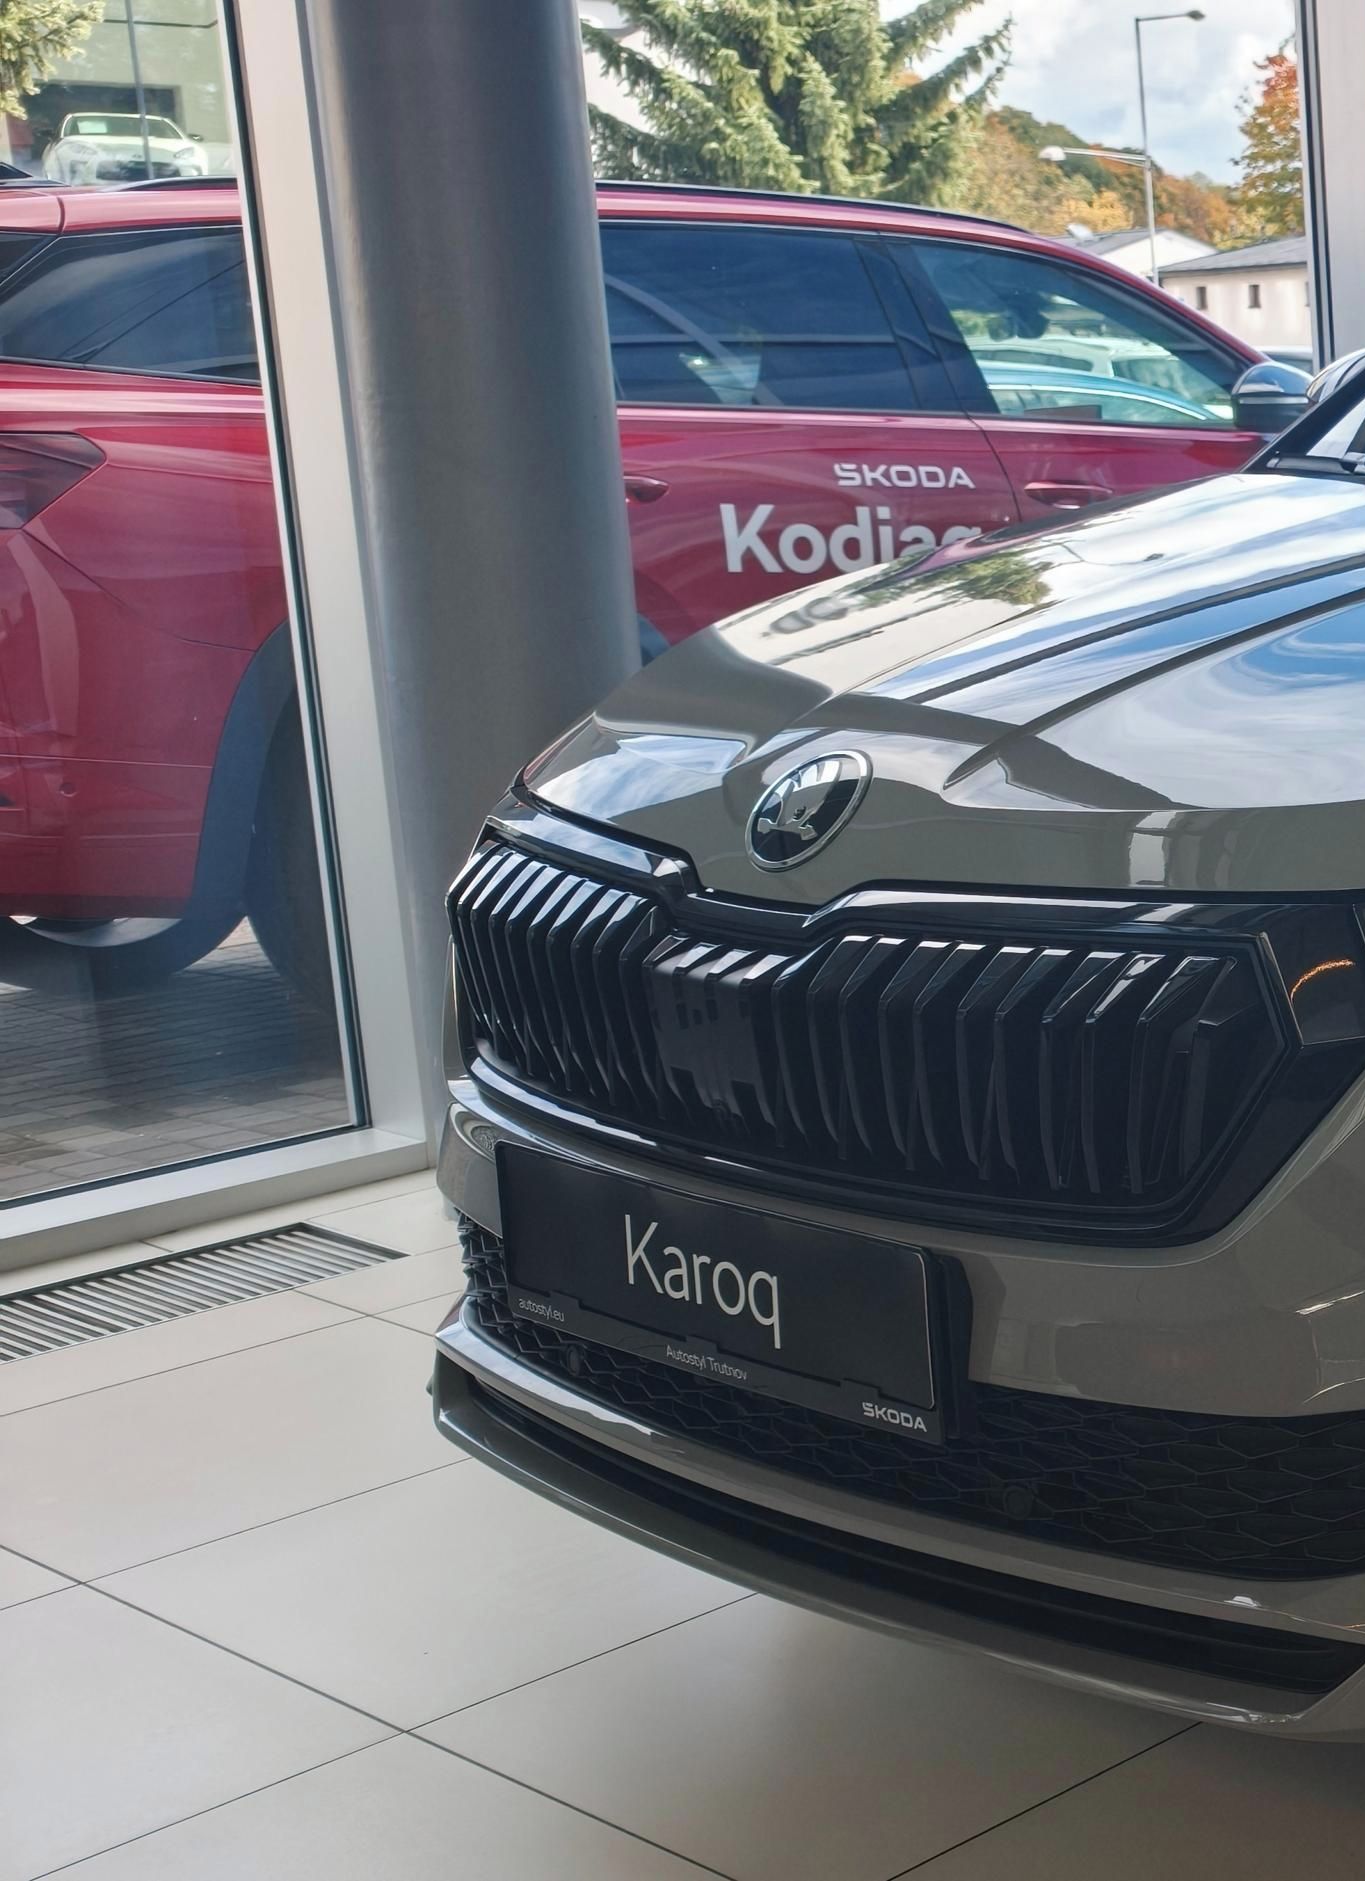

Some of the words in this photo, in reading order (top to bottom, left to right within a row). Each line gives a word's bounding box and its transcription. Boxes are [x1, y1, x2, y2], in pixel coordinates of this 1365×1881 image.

[624, 1213, 782, 1350] Karoq
[666, 1344, 707, 1371] Autostyl
[706, 1356, 748, 1381] Trutnov
